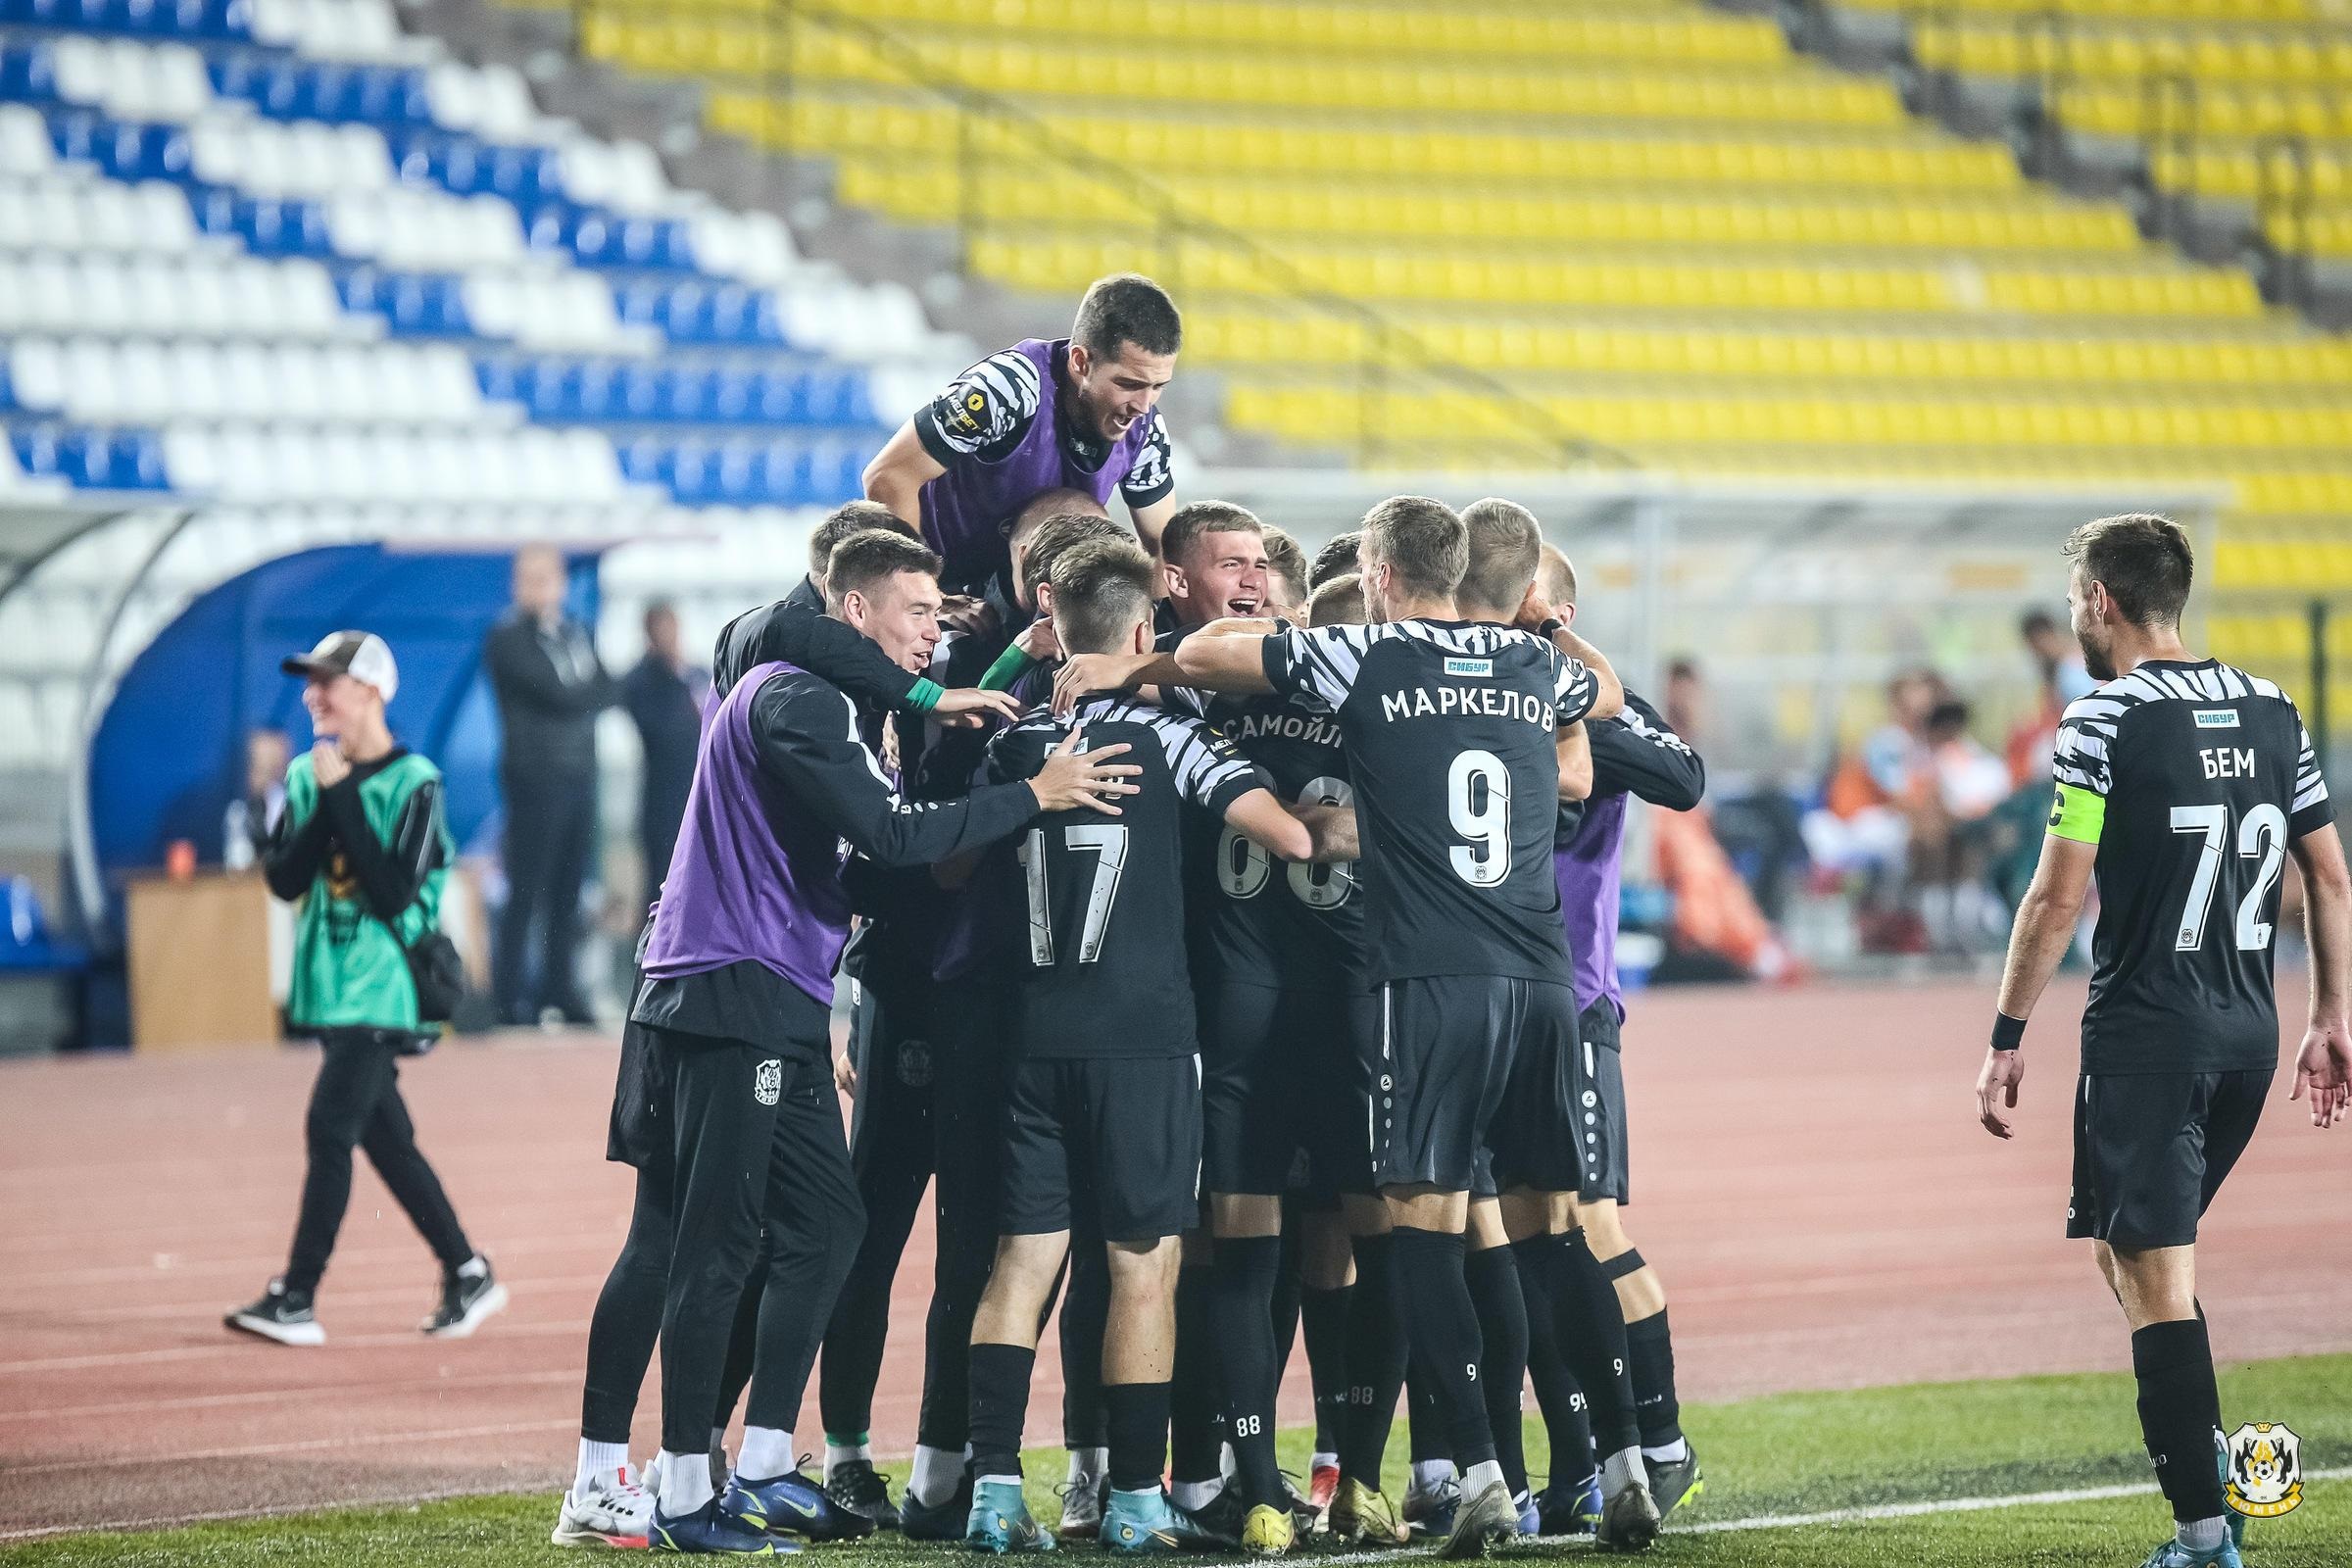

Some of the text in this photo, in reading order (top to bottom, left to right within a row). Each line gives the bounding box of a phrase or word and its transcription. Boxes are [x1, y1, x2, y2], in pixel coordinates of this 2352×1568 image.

[1448, 662, 1490, 672] СИБУР
[1381, 687, 1554, 733] МАРКЕЛОВ
[2197, 713, 2235, 724] СИБУР
[2199, 748, 2255, 780] БЕМ
[1447, 749, 1511, 889] 9
[2170, 803, 2287, 951] 72
[1016, 823, 1129, 966] 17
[1466, 1363, 1477, 1382] 9
[1613, 1357, 1623, 1376] 9
[1349, 1386, 1373, 1405] 88
[1236, 1414, 1261, 1438] 88
